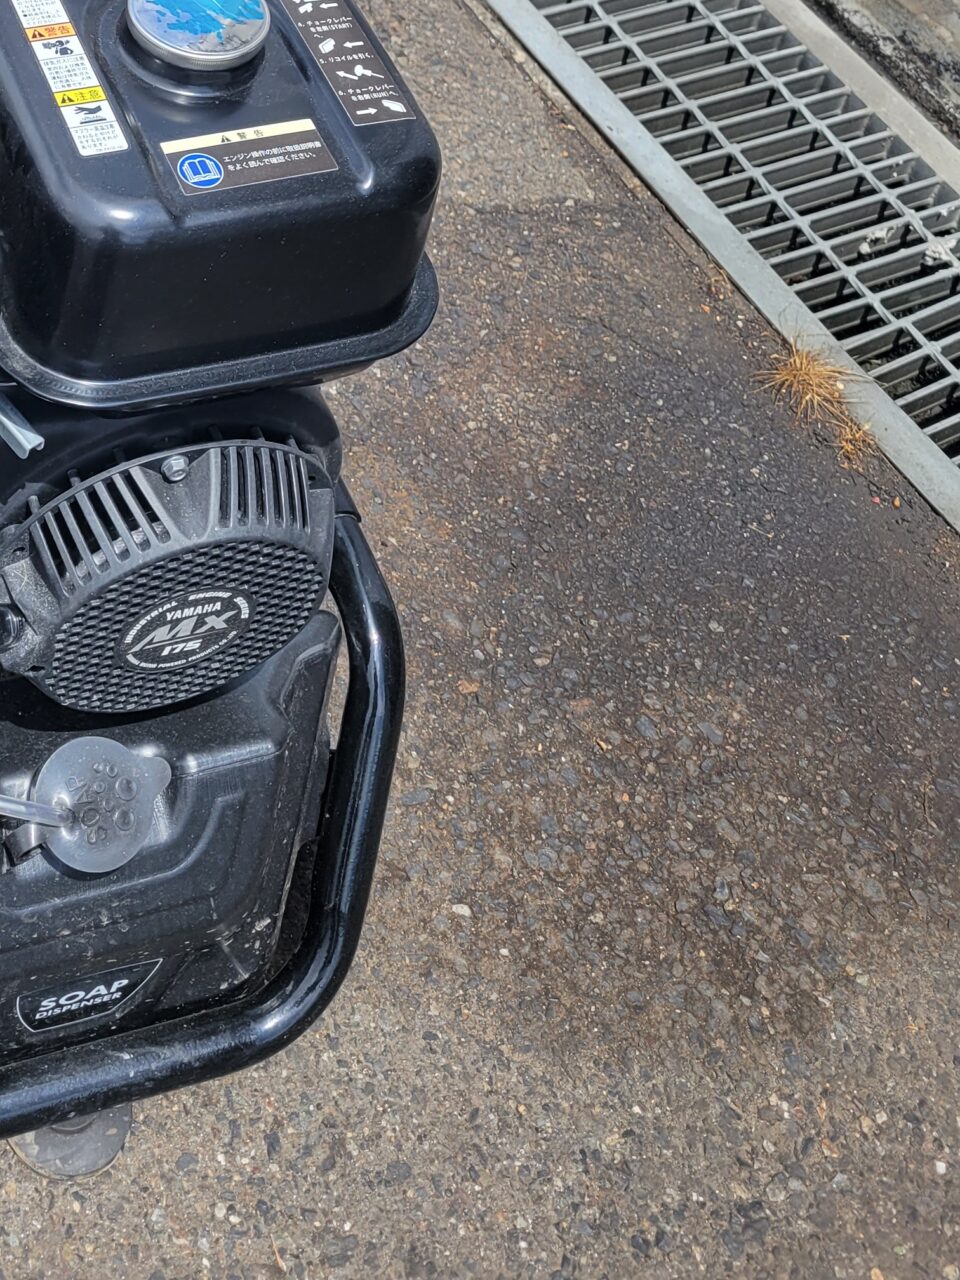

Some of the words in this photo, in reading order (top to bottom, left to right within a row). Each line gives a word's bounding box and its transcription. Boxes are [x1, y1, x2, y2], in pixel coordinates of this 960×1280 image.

[44, 25, 71, 37] 警告
[73, 89, 102, 102] 注意
[124, 601, 178, 643] INDUSTRIAL
[188, 591, 232, 601] ENGINE
[233, 596, 250, 619] SERIES
[166, 601, 222, 621] YAMAHA
[127, 609, 239, 654] MX
[161, 638, 203, 657] 175
[188, 644, 220, 661] PRODUCTS
[34, 991, 122, 1020] DISPENSER
[38, 979, 129, 1012] SOAP
